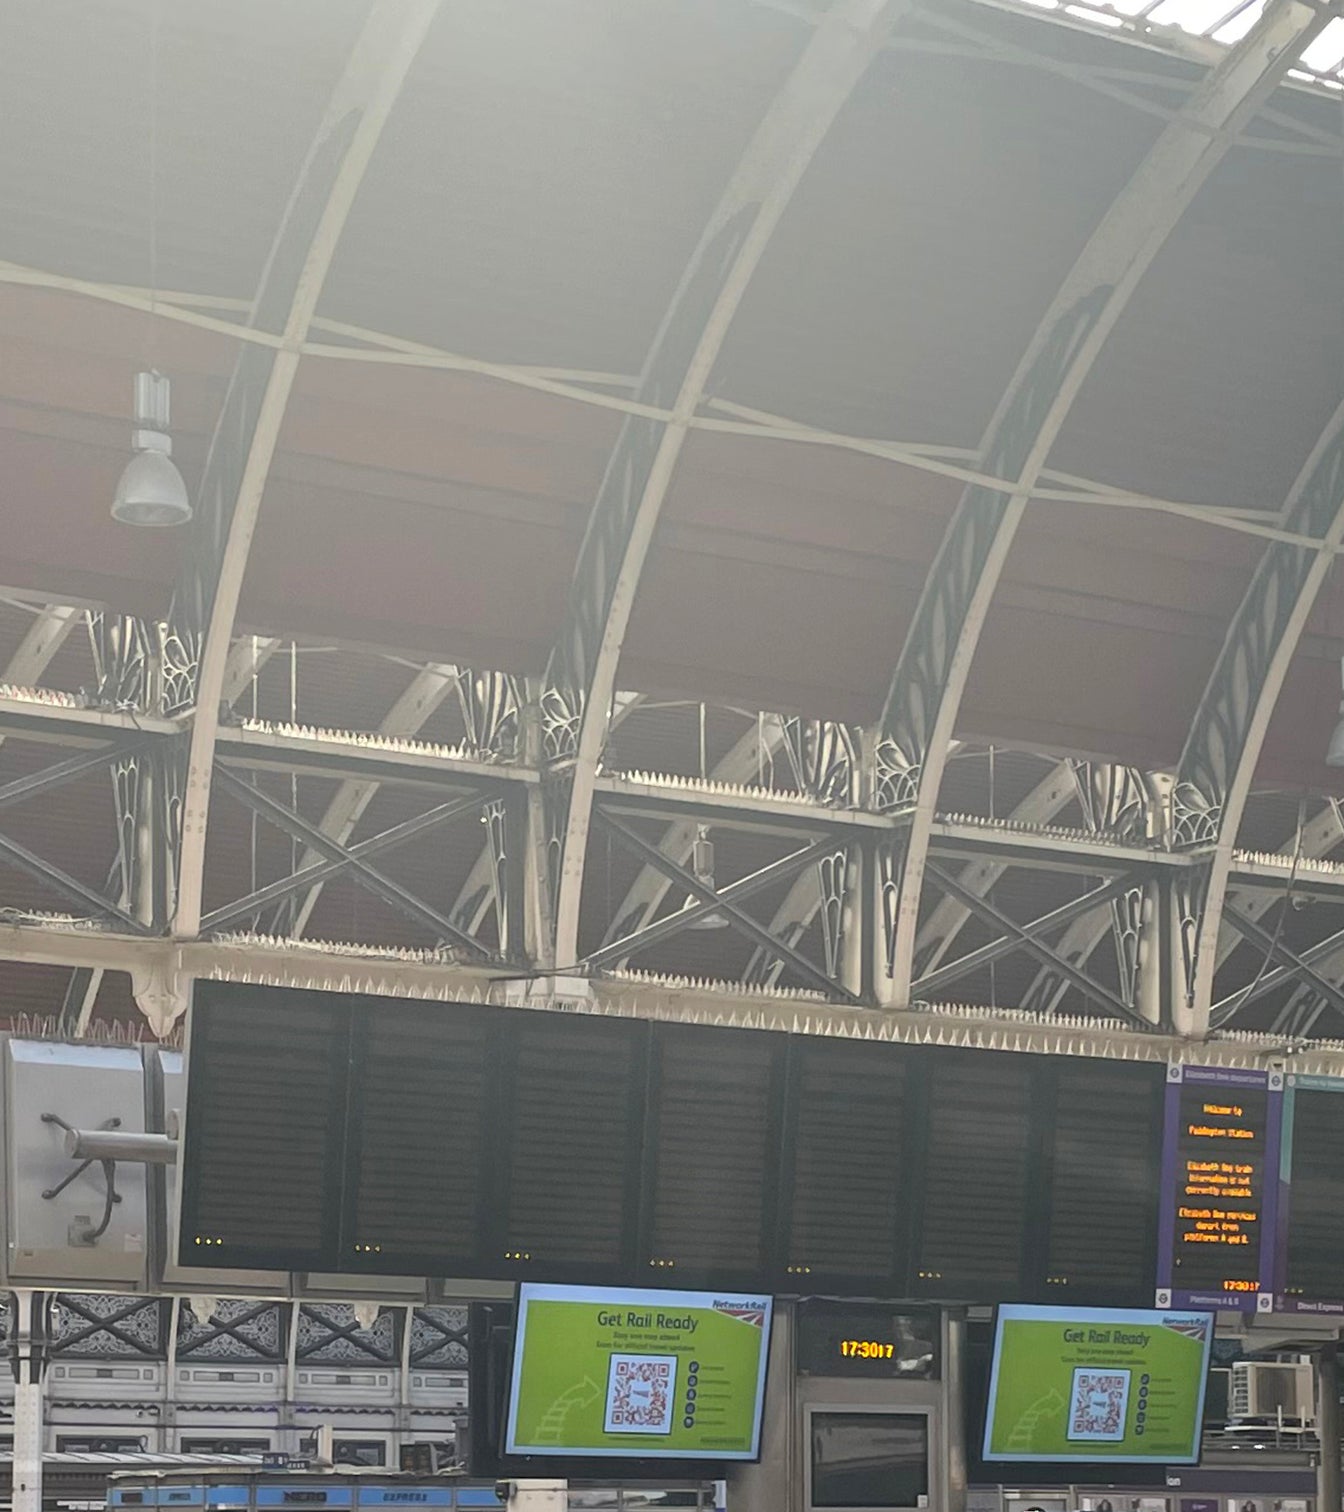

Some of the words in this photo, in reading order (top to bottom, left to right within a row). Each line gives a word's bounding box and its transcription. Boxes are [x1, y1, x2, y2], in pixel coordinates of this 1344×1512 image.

[1188, 1125, 1226, 1138] Paddington
[1228, 1128, 1254, 1139] Station
[597, 1311, 622, 1327] Get
[627, 1311, 652, 1328] Rail
[657, 1313, 699, 1333] Ready
[1063, 1328, 1085, 1343] Get
[1088, 1330, 1110, 1344] Rail
[1113, 1331, 1151, 1348] Ready
[1166, 1475, 1181, 1487] ion
